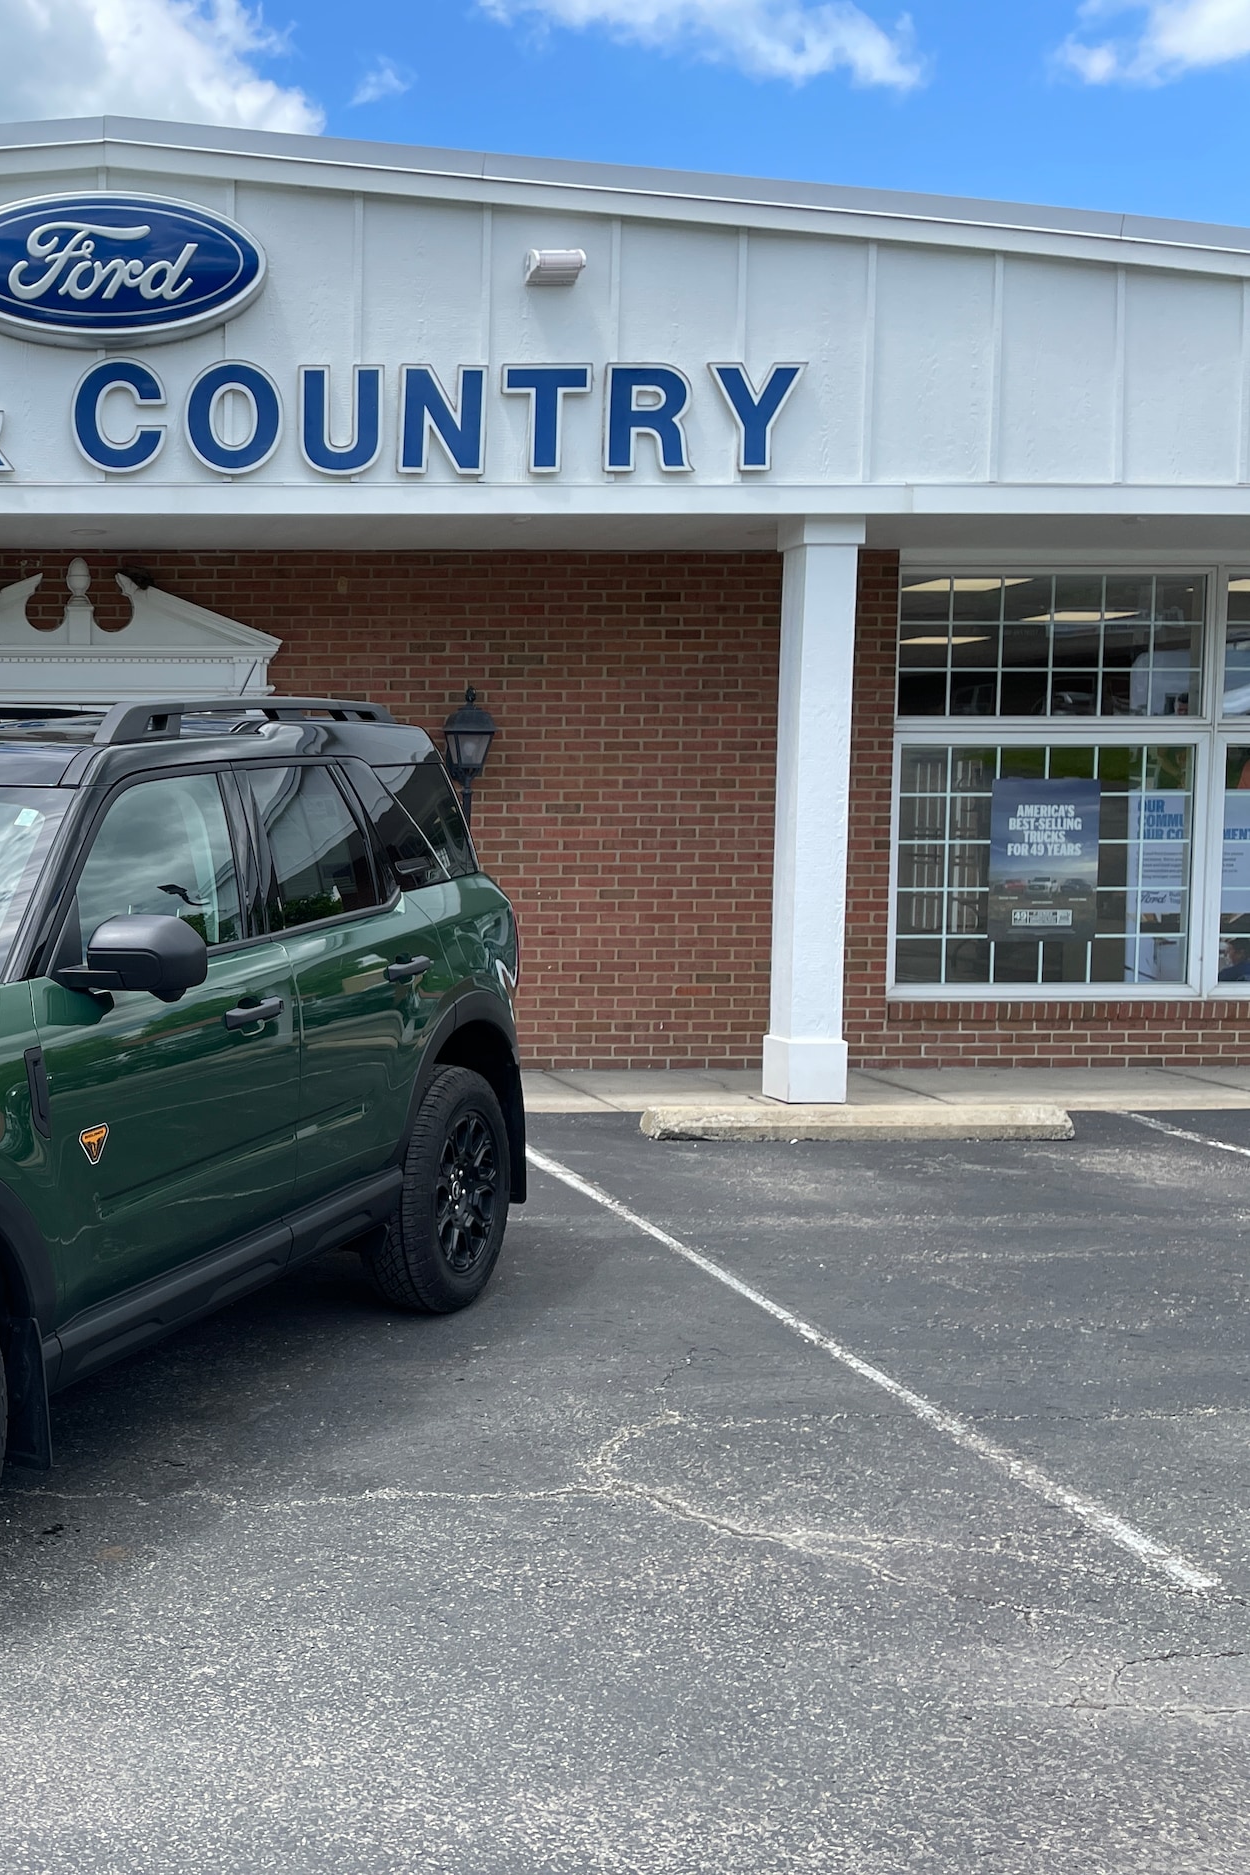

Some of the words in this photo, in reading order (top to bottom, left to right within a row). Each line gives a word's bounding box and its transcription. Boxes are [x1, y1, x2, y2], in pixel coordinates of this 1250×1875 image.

[8, 221, 199, 302] Ford
[71, 357, 809, 475] COUNTRY
[1016, 804, 1076, 817] AMERICA'S
[1008, 817, 1082, 831] BEST-SELLING
[1023, 830, 1066, 843] TRUCKS
[1007, 843, 1029, 857] FOR
[1030, 843, 1045, 856] 49
[1047, 843, 1082, 857] YEARS
[1014, 911, 1028, 921] 49
